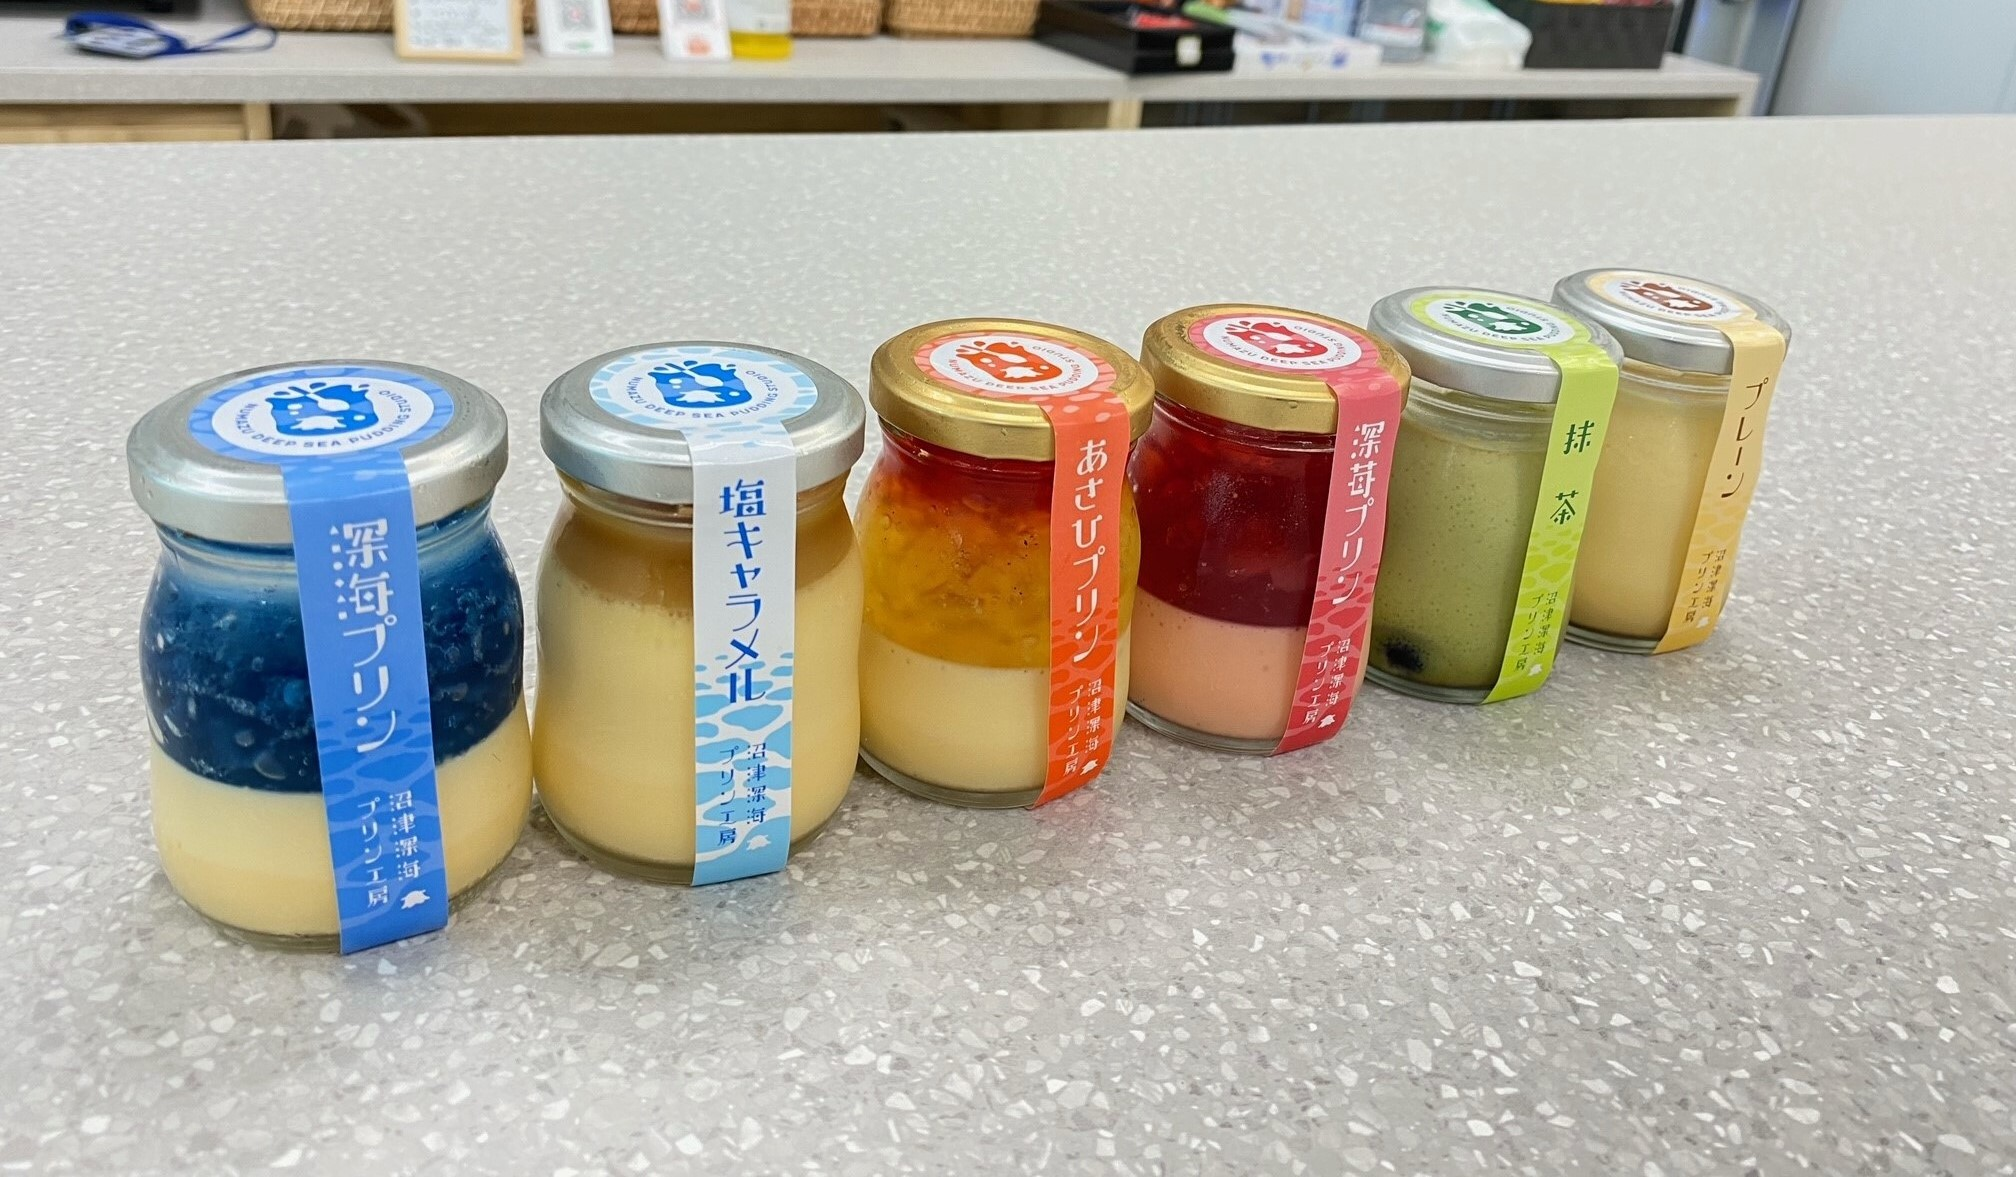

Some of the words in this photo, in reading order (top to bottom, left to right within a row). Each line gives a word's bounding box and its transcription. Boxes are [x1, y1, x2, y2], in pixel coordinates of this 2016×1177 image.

[745, 370, 778, 393] STUDIO
[985, 382, 1025, 390] DEEP
[1032, 345, 1075, 364] STUDIO
[1260, 356, 1298, 365] DEEP
[1293, 325, 1338, 343] STUDIO
[235, 403, 258, 436] NUMAZU
[378, 389, 412, 414] STUDIO
[626, 376, 643, 405] NUMAZU
[646, 403, 686, 417] DEEP
[731, 392, 778, 417] PUDDING
[251, 433, 297, 448] DEEP
[303, 440, 342, 448] SEA
[348, 414, 409, 444] PUDDING
[1721, 377, 1769, 499] プレーン
[1550, 420, 1595, 525] 抹茶
[1332, 420, 1386, 605] 深苺プリン
[1071, 439, 1108, 663] あさひプリン
[718, 479, 767, 704] 塩キャラメル
[330, 518, 398, 753] 深海プリン
[1325, 638, 1351, 707] 沼津深海
[1085, 678, 1103, 754] 沼津深海
[1303, 641, 1334, 725] プリン工房
[1062, 685, 1085, 777] プリン工房
[717, 746, 740, 846] プリン工房
[747, 743, 767, 825] 沼津深海
[357, 797, 389, 908] プリン工房
[388, 789, 422, 881] 沼津深海
